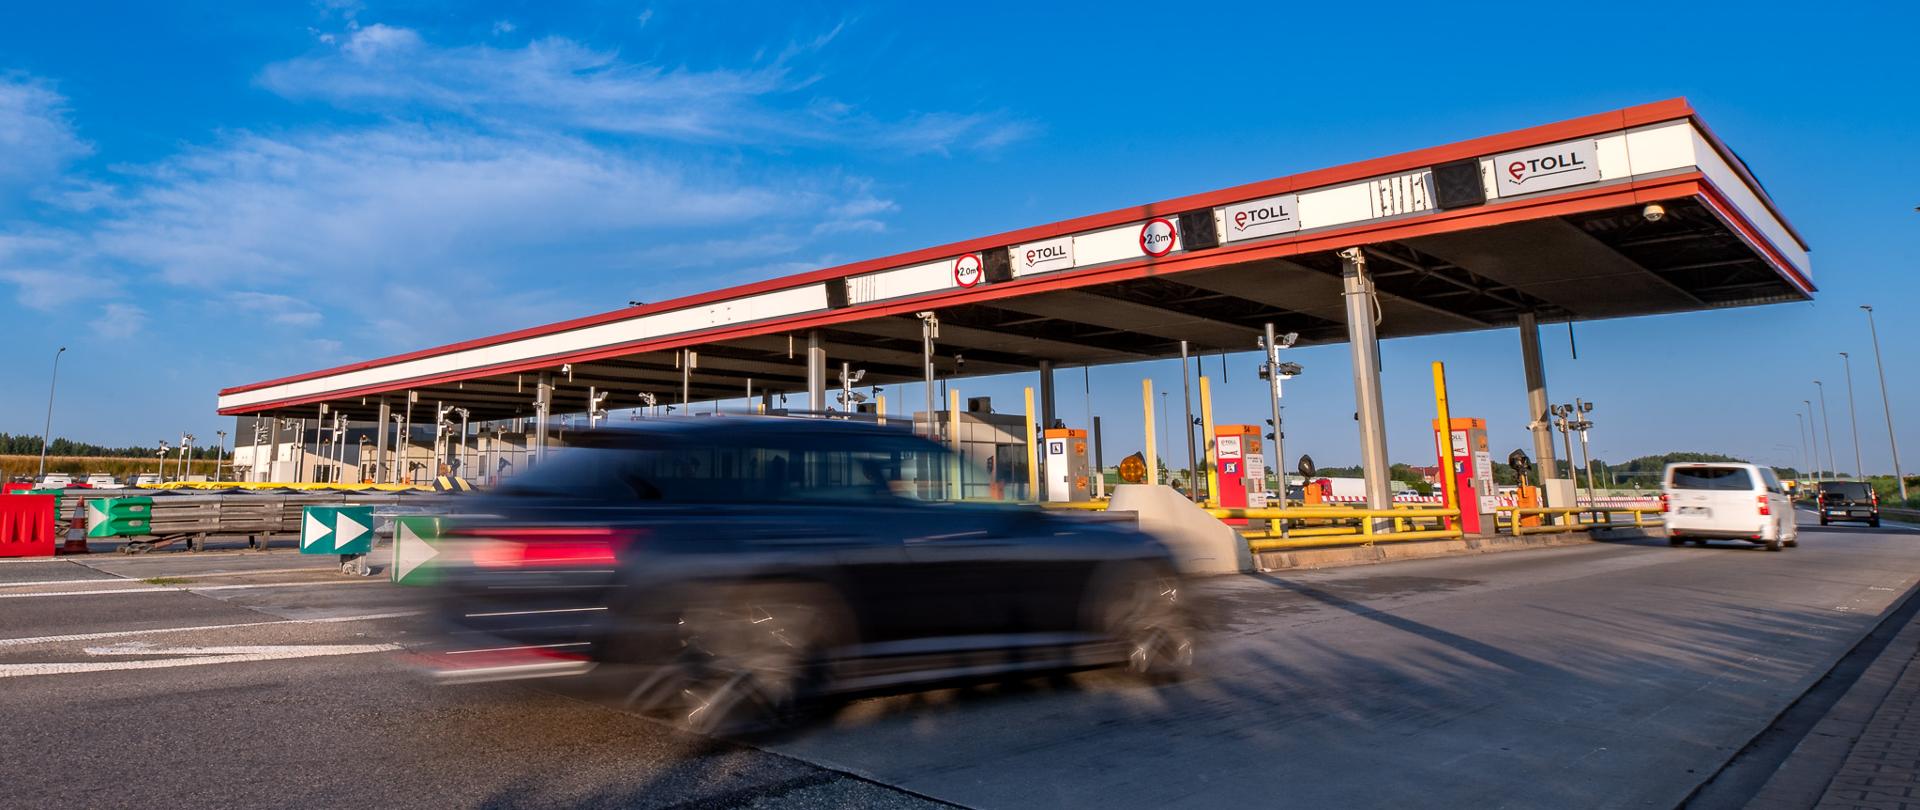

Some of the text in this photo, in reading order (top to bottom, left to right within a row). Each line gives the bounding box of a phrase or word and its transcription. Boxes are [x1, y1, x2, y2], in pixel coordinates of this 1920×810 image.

[1509, 152, 1584, 180] eTOLL
[1235, 205, 1289, 228] eTOLL
[1146, 233, 1169, 244] 2.0m
[1026, 245, 1066, 264] eTOLL
[960, 267, 976, 277] 2.0m
